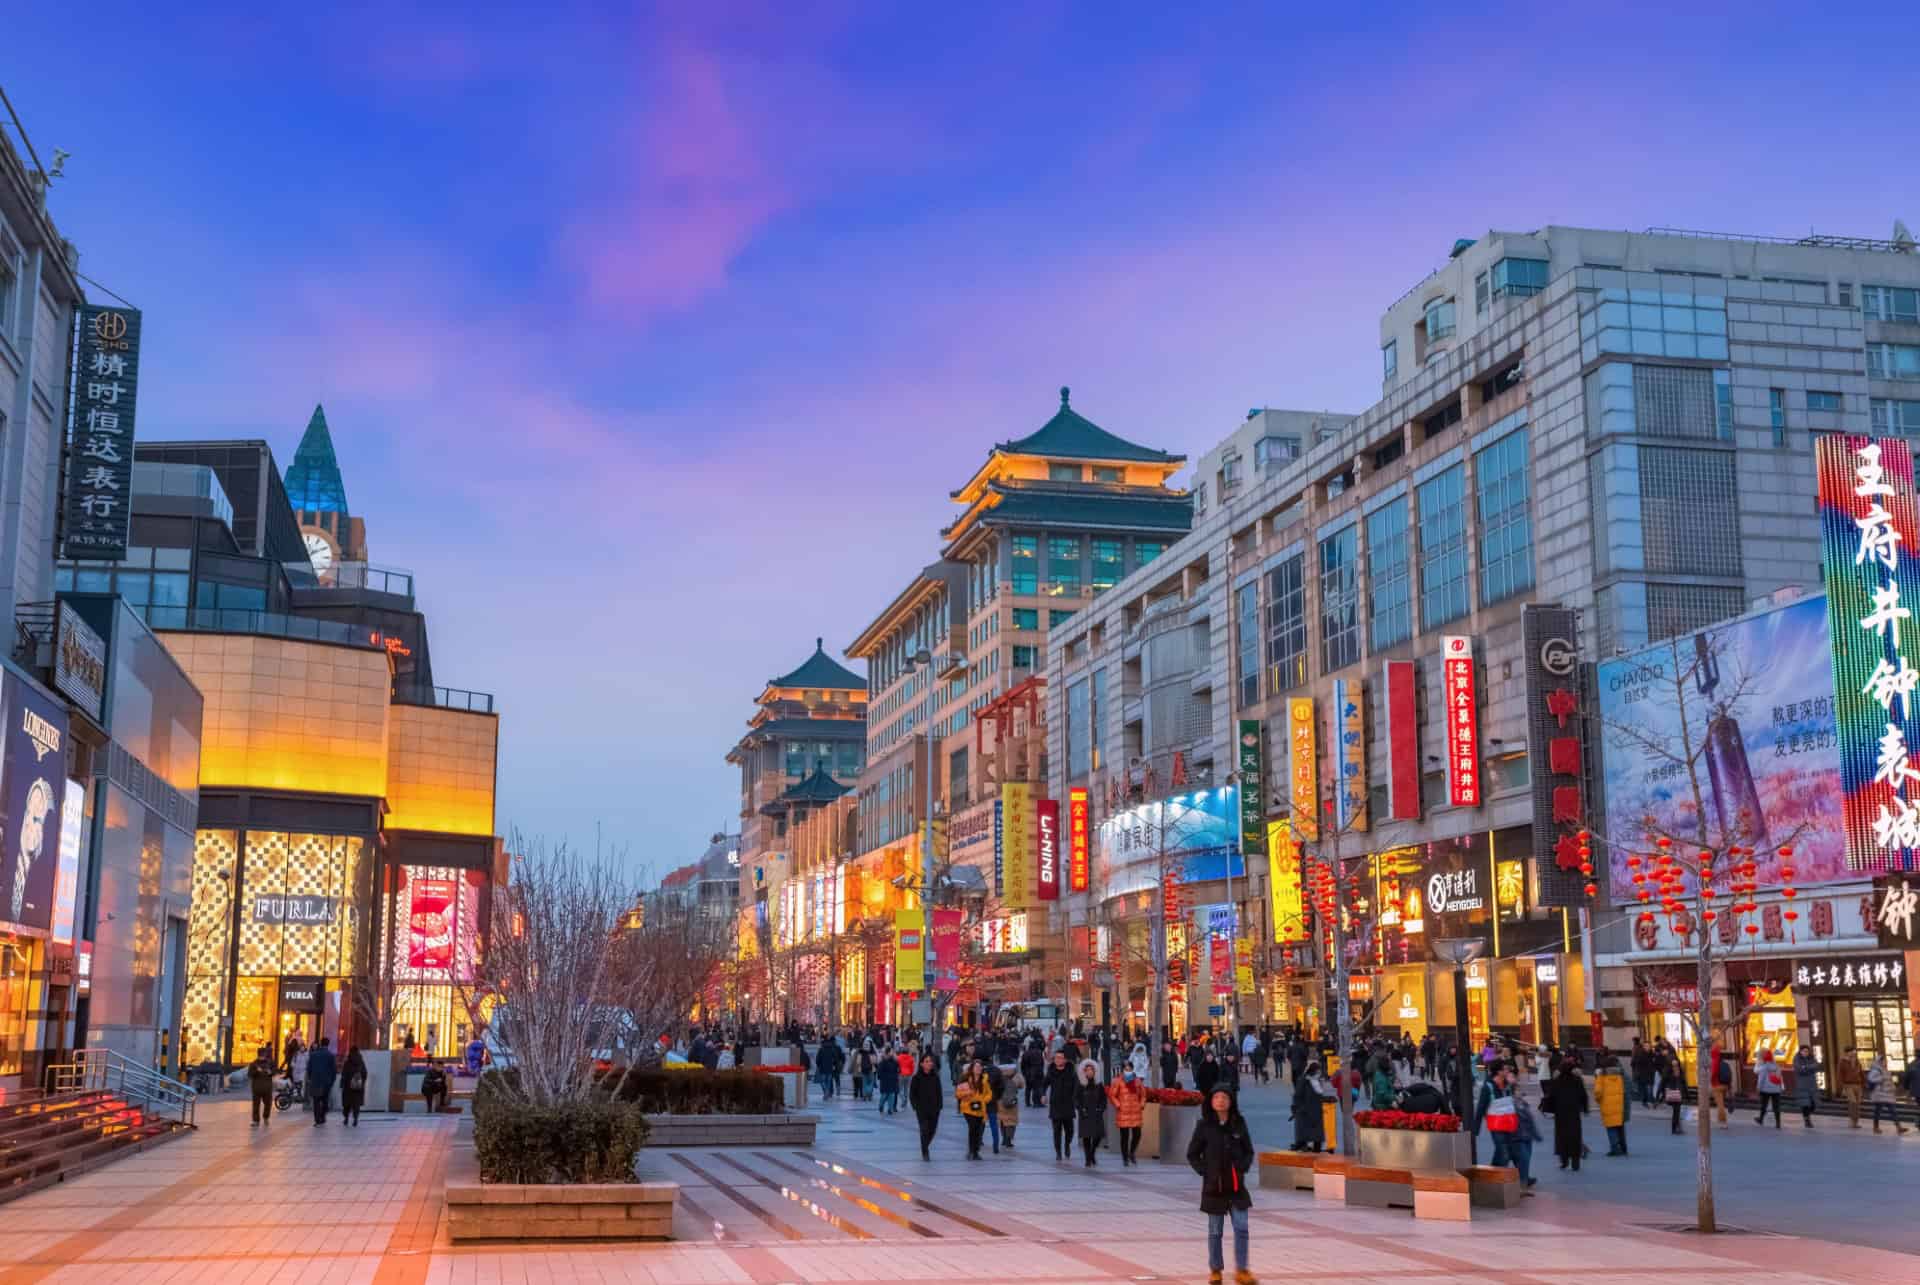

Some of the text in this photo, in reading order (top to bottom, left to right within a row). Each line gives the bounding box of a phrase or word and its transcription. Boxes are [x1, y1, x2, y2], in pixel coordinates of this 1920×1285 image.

[80, 353, 128, 518] 精时恒达表行
[1855, 443, 1920, 850] 王府井钟表城
[23, 707, 60, 752] LONGINES
[1455, 661, 1474, 802] 北京全聚德王府井店
[1041, 815, 1053, 883] LI-NING
[1444, 868, 1477, 897] 亨得利
[1446, 898, 1484, 912] HENGDELI
[256, 898, 334, 921] FURLA
[1877, 880, 1918, 941] 钟
[285, 991, 313, 1000] FURLA
